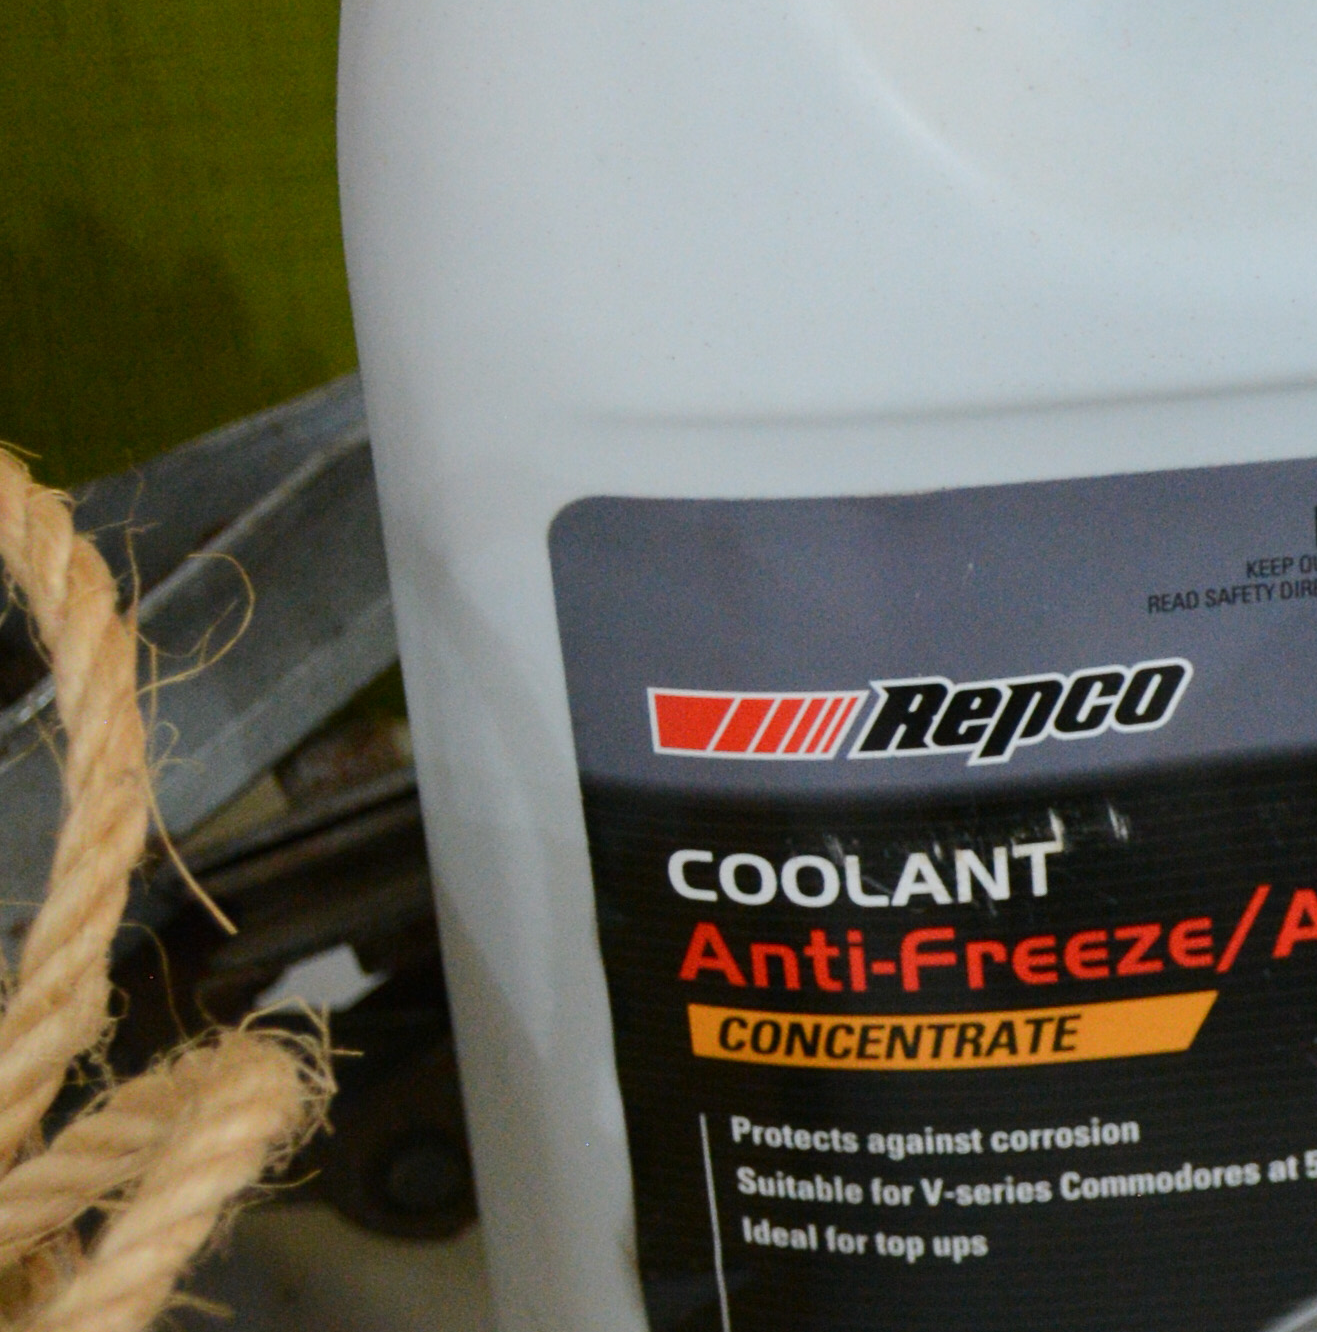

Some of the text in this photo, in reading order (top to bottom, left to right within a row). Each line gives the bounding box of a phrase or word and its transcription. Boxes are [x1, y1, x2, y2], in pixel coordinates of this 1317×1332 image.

[1246, 556, 1294, 579] KEEP
[1147, 590, 1200, 614] READ
[1204, 583, 1274, 609] SAFETY
[667, 839, 1064, 908] COOLANT
[717, 1014, 1082, 1061] CONCENTRATE
[730, 1115, 1141, 1161] Protects against corrosion
[735, 1165, 864, 1205] Suitable
[871, 1176, 915, 1207] for
[919, 1174, 1053, 1207] V-series
[1059, 1162, 1262, 1201] Commodores
[1267, 1154, 1299, 1183] at
[741, 1215, 989, 1264] Ideal for top ups
